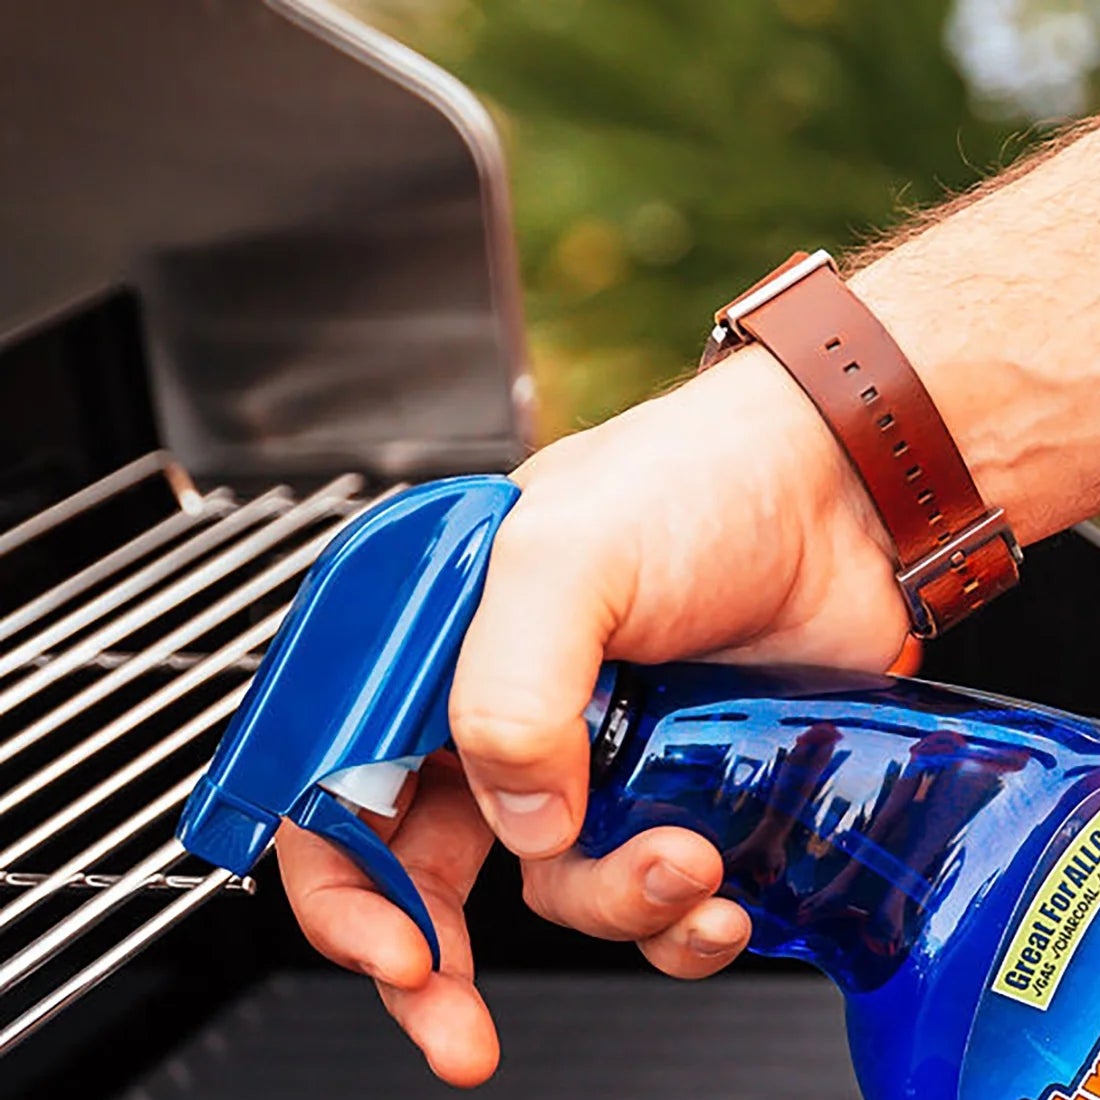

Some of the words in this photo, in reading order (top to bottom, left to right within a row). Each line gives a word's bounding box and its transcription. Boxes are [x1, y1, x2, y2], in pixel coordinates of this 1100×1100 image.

[1005, 921, 1055, 990] Great
[1039, 882, 1076, 923] For
[1064, 846, 1100, 889] ALL
